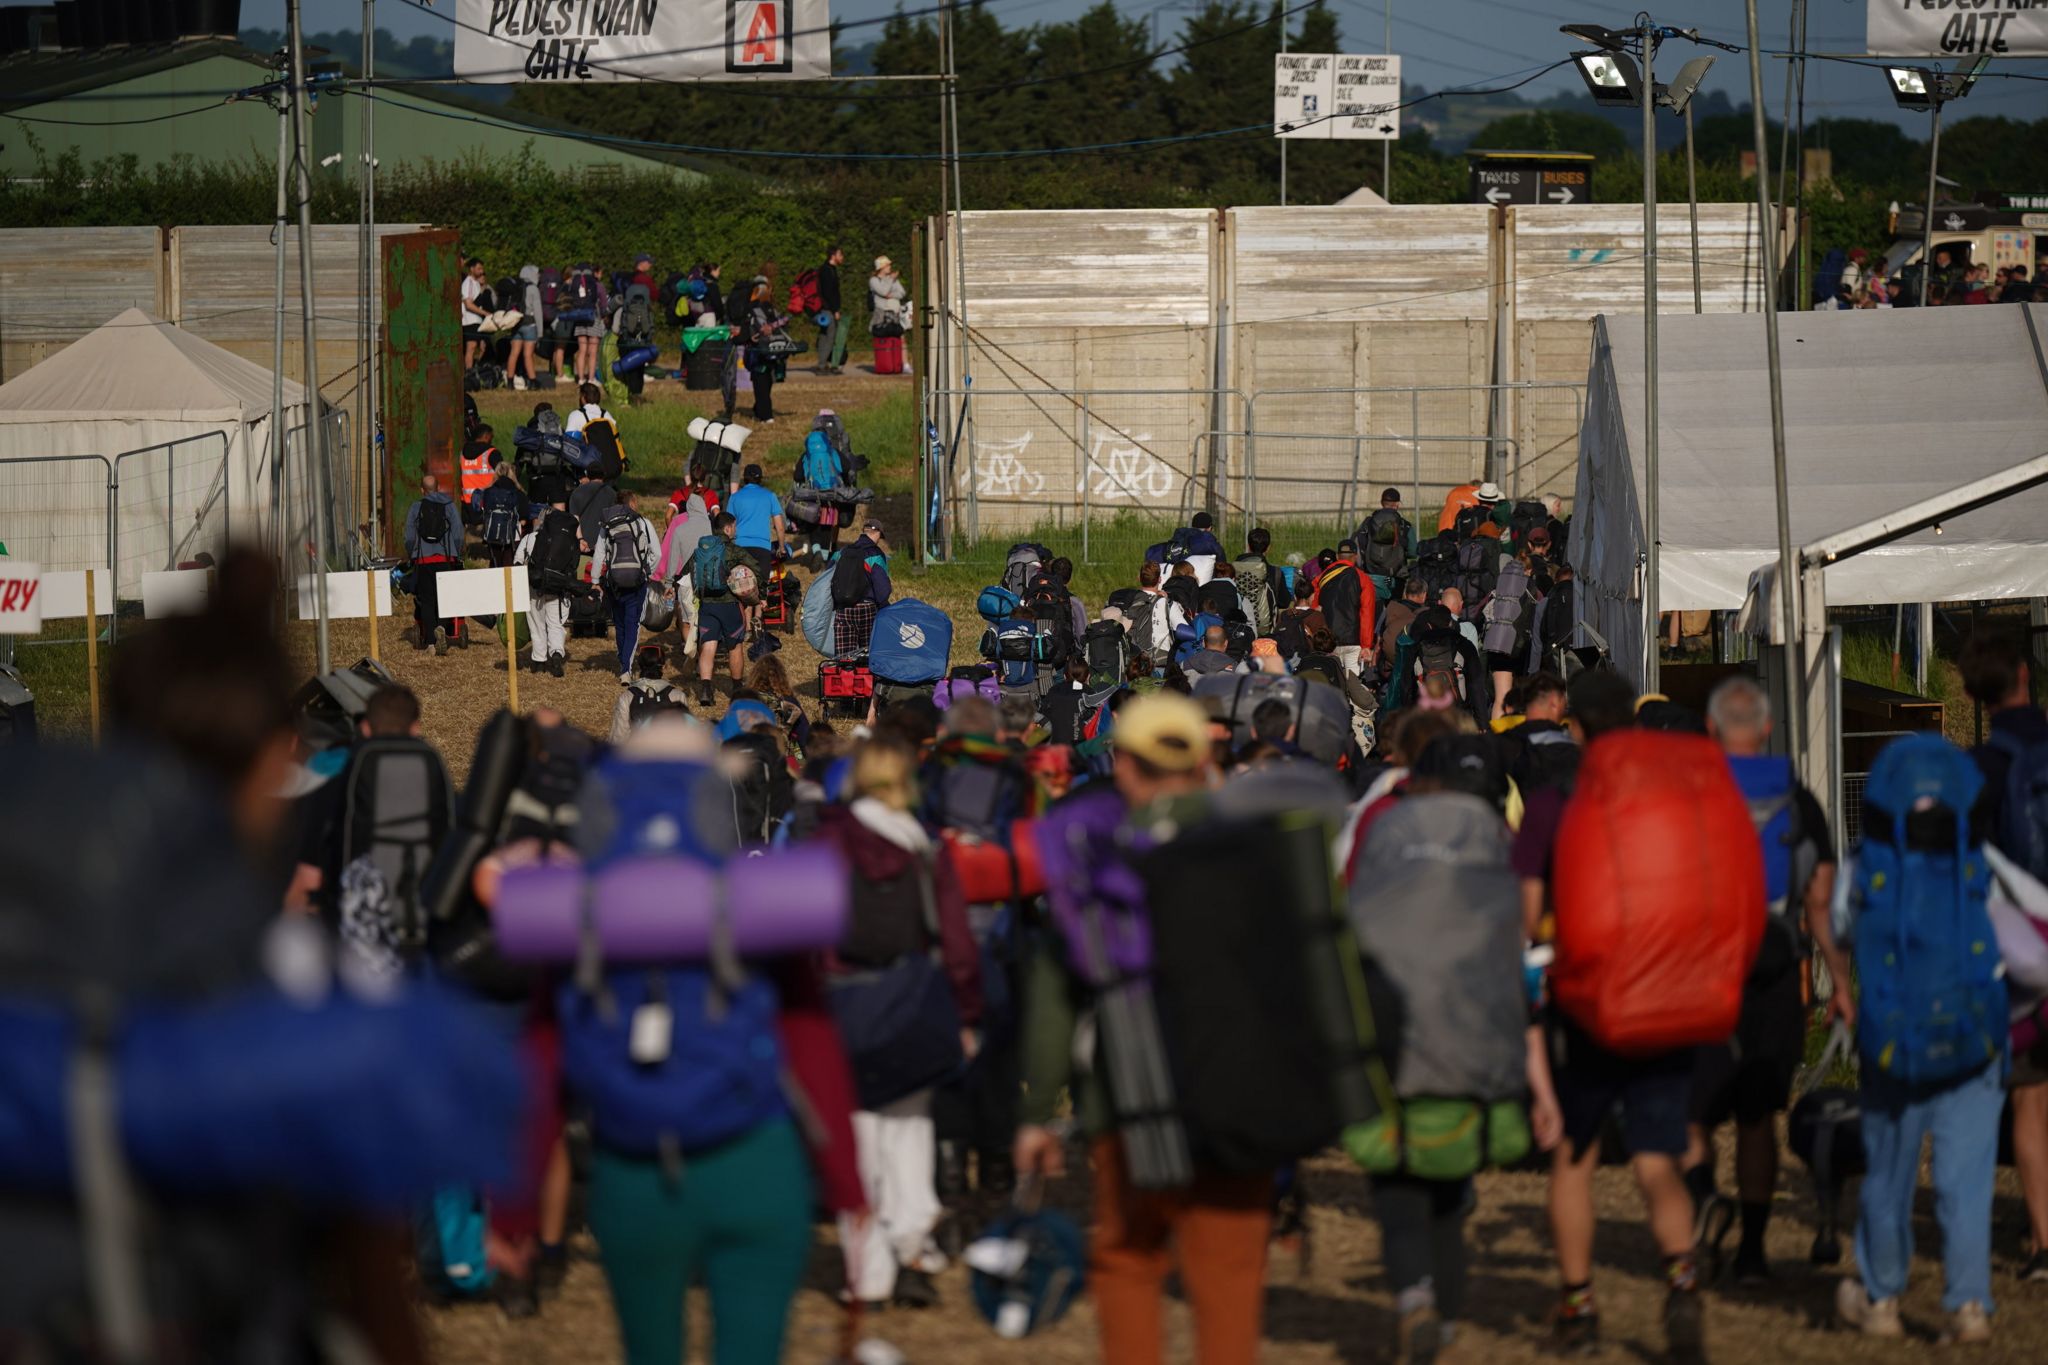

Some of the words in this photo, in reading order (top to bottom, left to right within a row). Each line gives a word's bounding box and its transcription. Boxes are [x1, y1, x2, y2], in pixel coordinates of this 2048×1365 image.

[488, 0, 658, 36] PEDESTRIAN
[743, 3, 776, 62] A
[1940, 12, 2016, 53] GATE
[525, 38, 599, 79] GATE
[1479, 171, 1520, 185] TAXIS
[1543, 171, 1585, 185] BUSES
